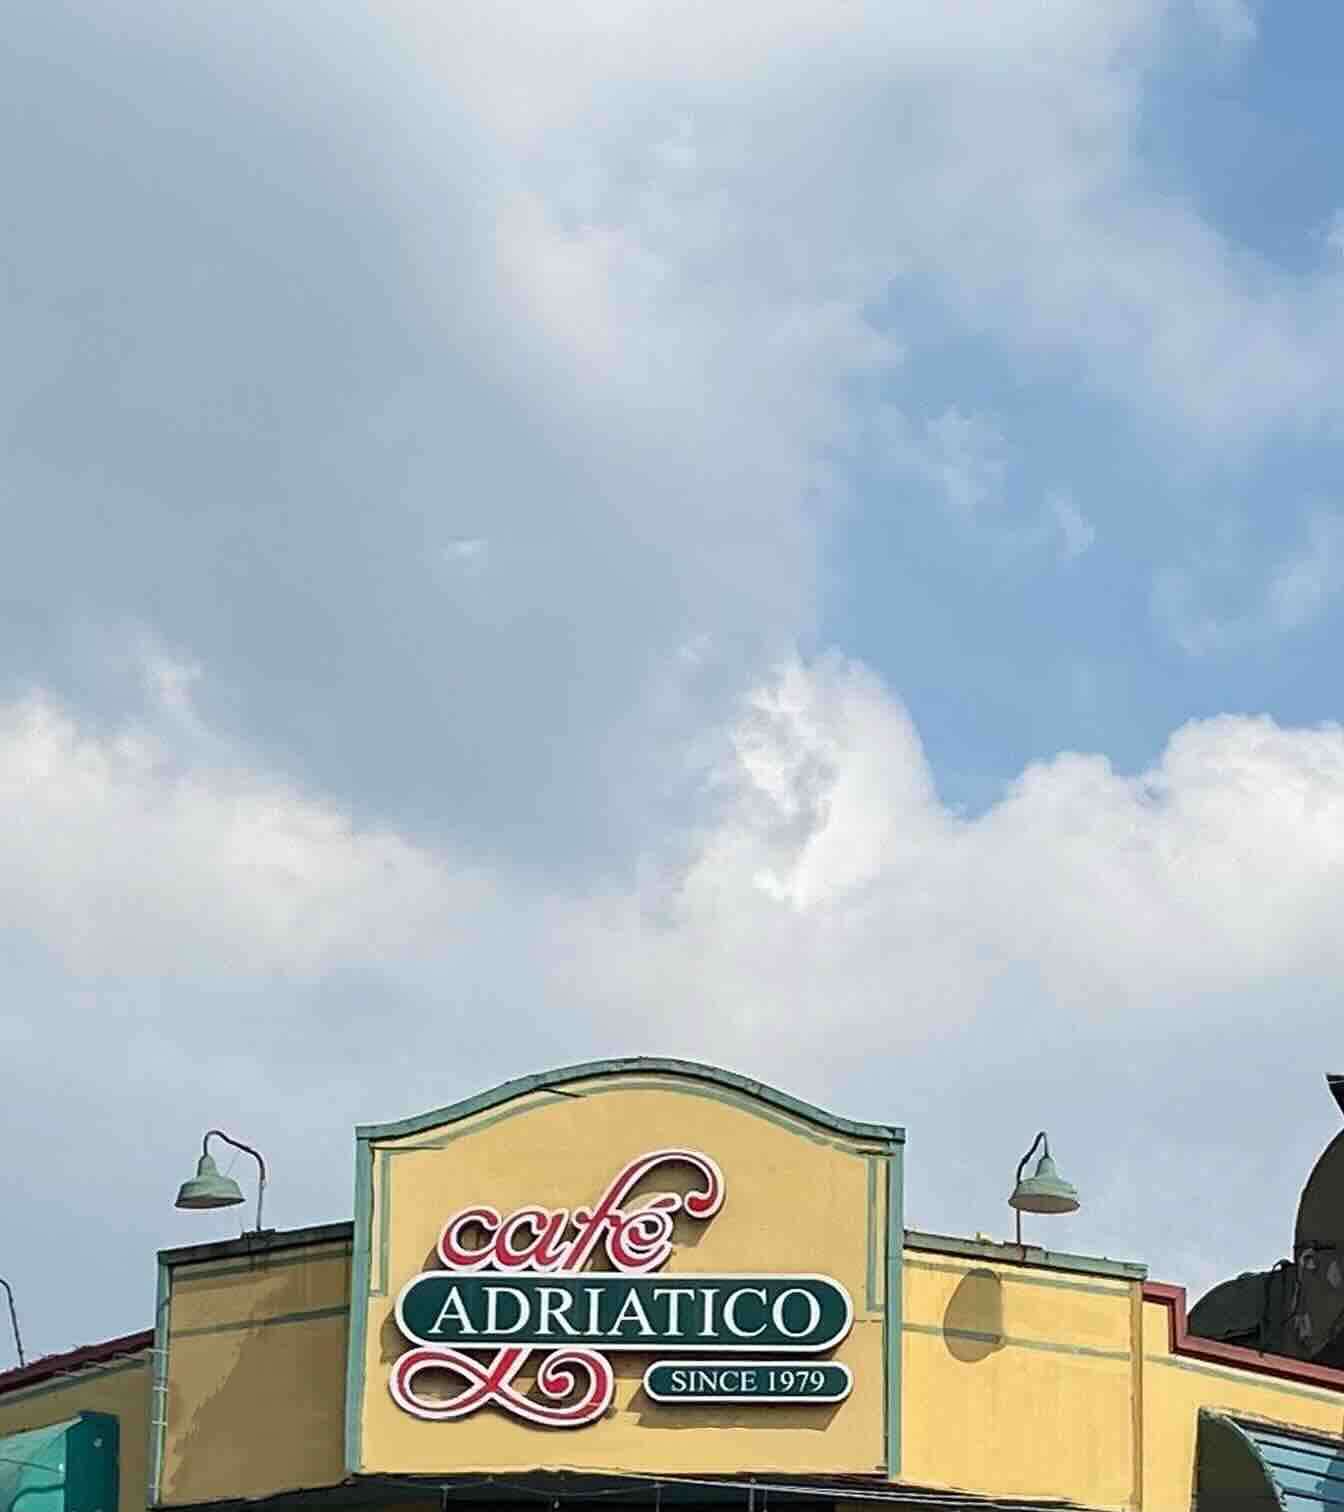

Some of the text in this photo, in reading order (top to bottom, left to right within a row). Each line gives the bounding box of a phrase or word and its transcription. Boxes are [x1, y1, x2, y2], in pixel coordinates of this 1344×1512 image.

[427, 1287, 821, 1338] ADRIATICO
[670, 1369, 826, 1394] SINCE 1979
